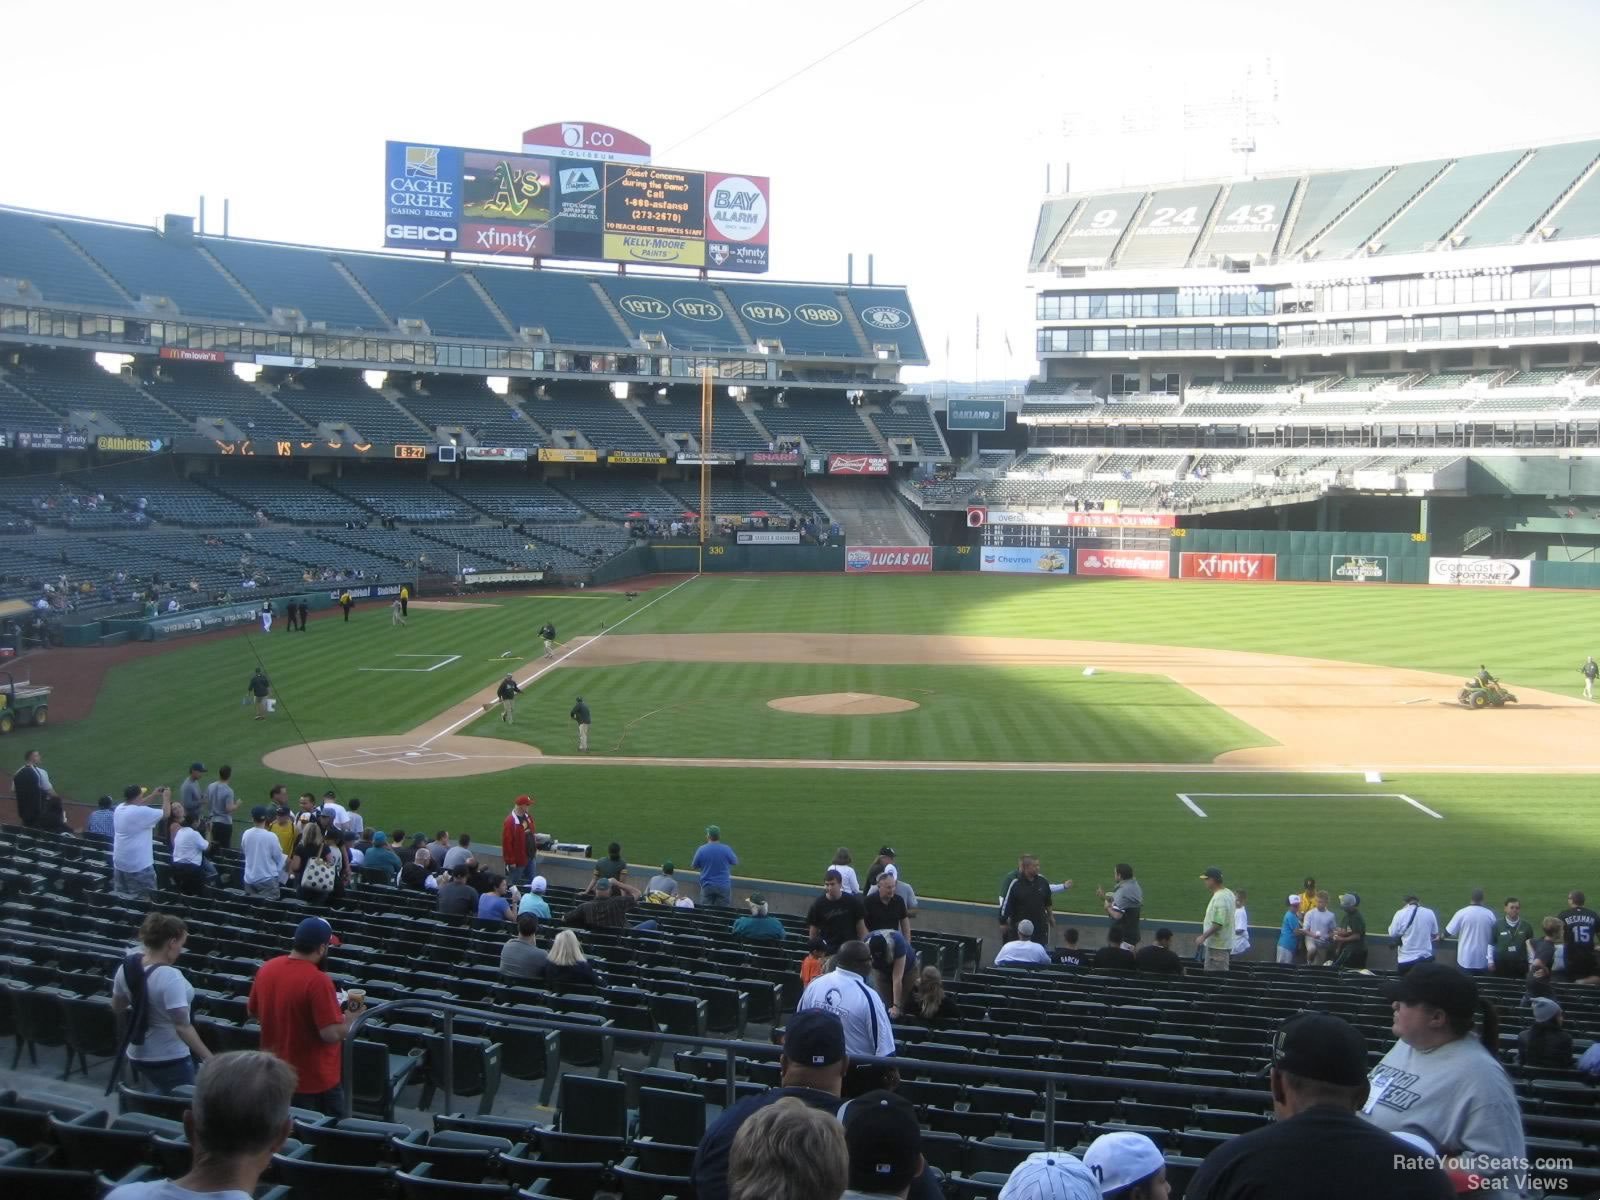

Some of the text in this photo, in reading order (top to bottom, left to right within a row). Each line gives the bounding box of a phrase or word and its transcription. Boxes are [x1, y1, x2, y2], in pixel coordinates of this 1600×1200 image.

[561, 150, 615, 160] COLISEUM
[626, 168, 685, 181] Guest Concerns
[391, 178, 453, 195] CACHE
[622, 178, 688, 192] during the Game?
[391, 192, 453, 209] CREEK
[647, 190, 664, 199] Call
[714, 189, 760, 211] BAY
[391, 207, 453, 218] CASINO RESORT
[713, 210, 759, 224] ALARM
[1090, 209, 1118, 229] 9
[1149, 206, 1199, 227] 24
[1225, 204, 1276, 225] 43
[386, 224, 458, 242] GEICO
[615, 223, 635, 231] REACH
[656, 226, 684, 234] SERVICES
[685, 228, 703, 236] STAFF
[476, 227, 537, 252] xfinity
[623, 236, 686, 249] KELLY-MOORE
[641, 249, 667, 258] PAINTS
[737, 247, 766, 259] xfinity
[625, 299, 666, 314] 1972
[679, 302, 718, 316] 1973
[747, 306, 786, 319] 1974
[800, 308, 839, 322] 1989
[952, 411, 990, 419] OAKLAND
[66, 435, 87, 446] xfinity
[98, 436, 151, 451] @Athletics
[277, 441, 291, 456] VS
[752, 453, 798, 461] SHARP
[1171, 528, 1186, 537] 362
[709, 546, 724, 555] 330
[872, 553, 909, 566] LUCAS
[911, 553, 929, 566] OIL
[998, 555, 1032, 563] Chevron
[1198, 555, 1259, 577] xfinity
[1336, 567, 1383, 576] CHAMPIONS
[1572, 925, 1590, 942] 15
